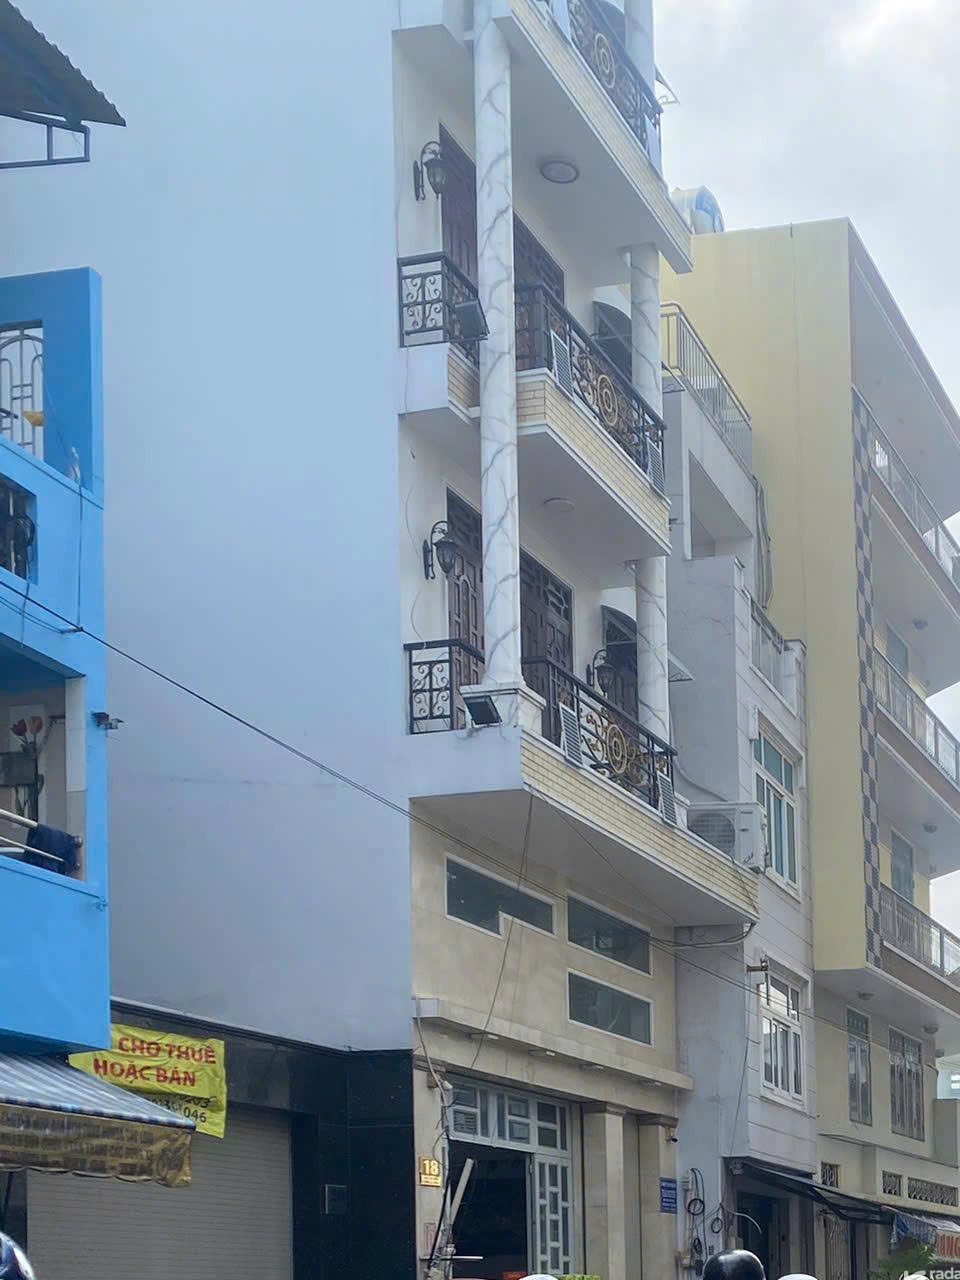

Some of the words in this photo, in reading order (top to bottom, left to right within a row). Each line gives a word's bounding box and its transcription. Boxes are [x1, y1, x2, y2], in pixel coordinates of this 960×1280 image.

[117, 1036, 162, 1058] CHO
[165, 1043, 217, 1065] THUÊ
[155, 1066, 196, 1087] BÁN
[423, 1159, 440, 1175] 18
